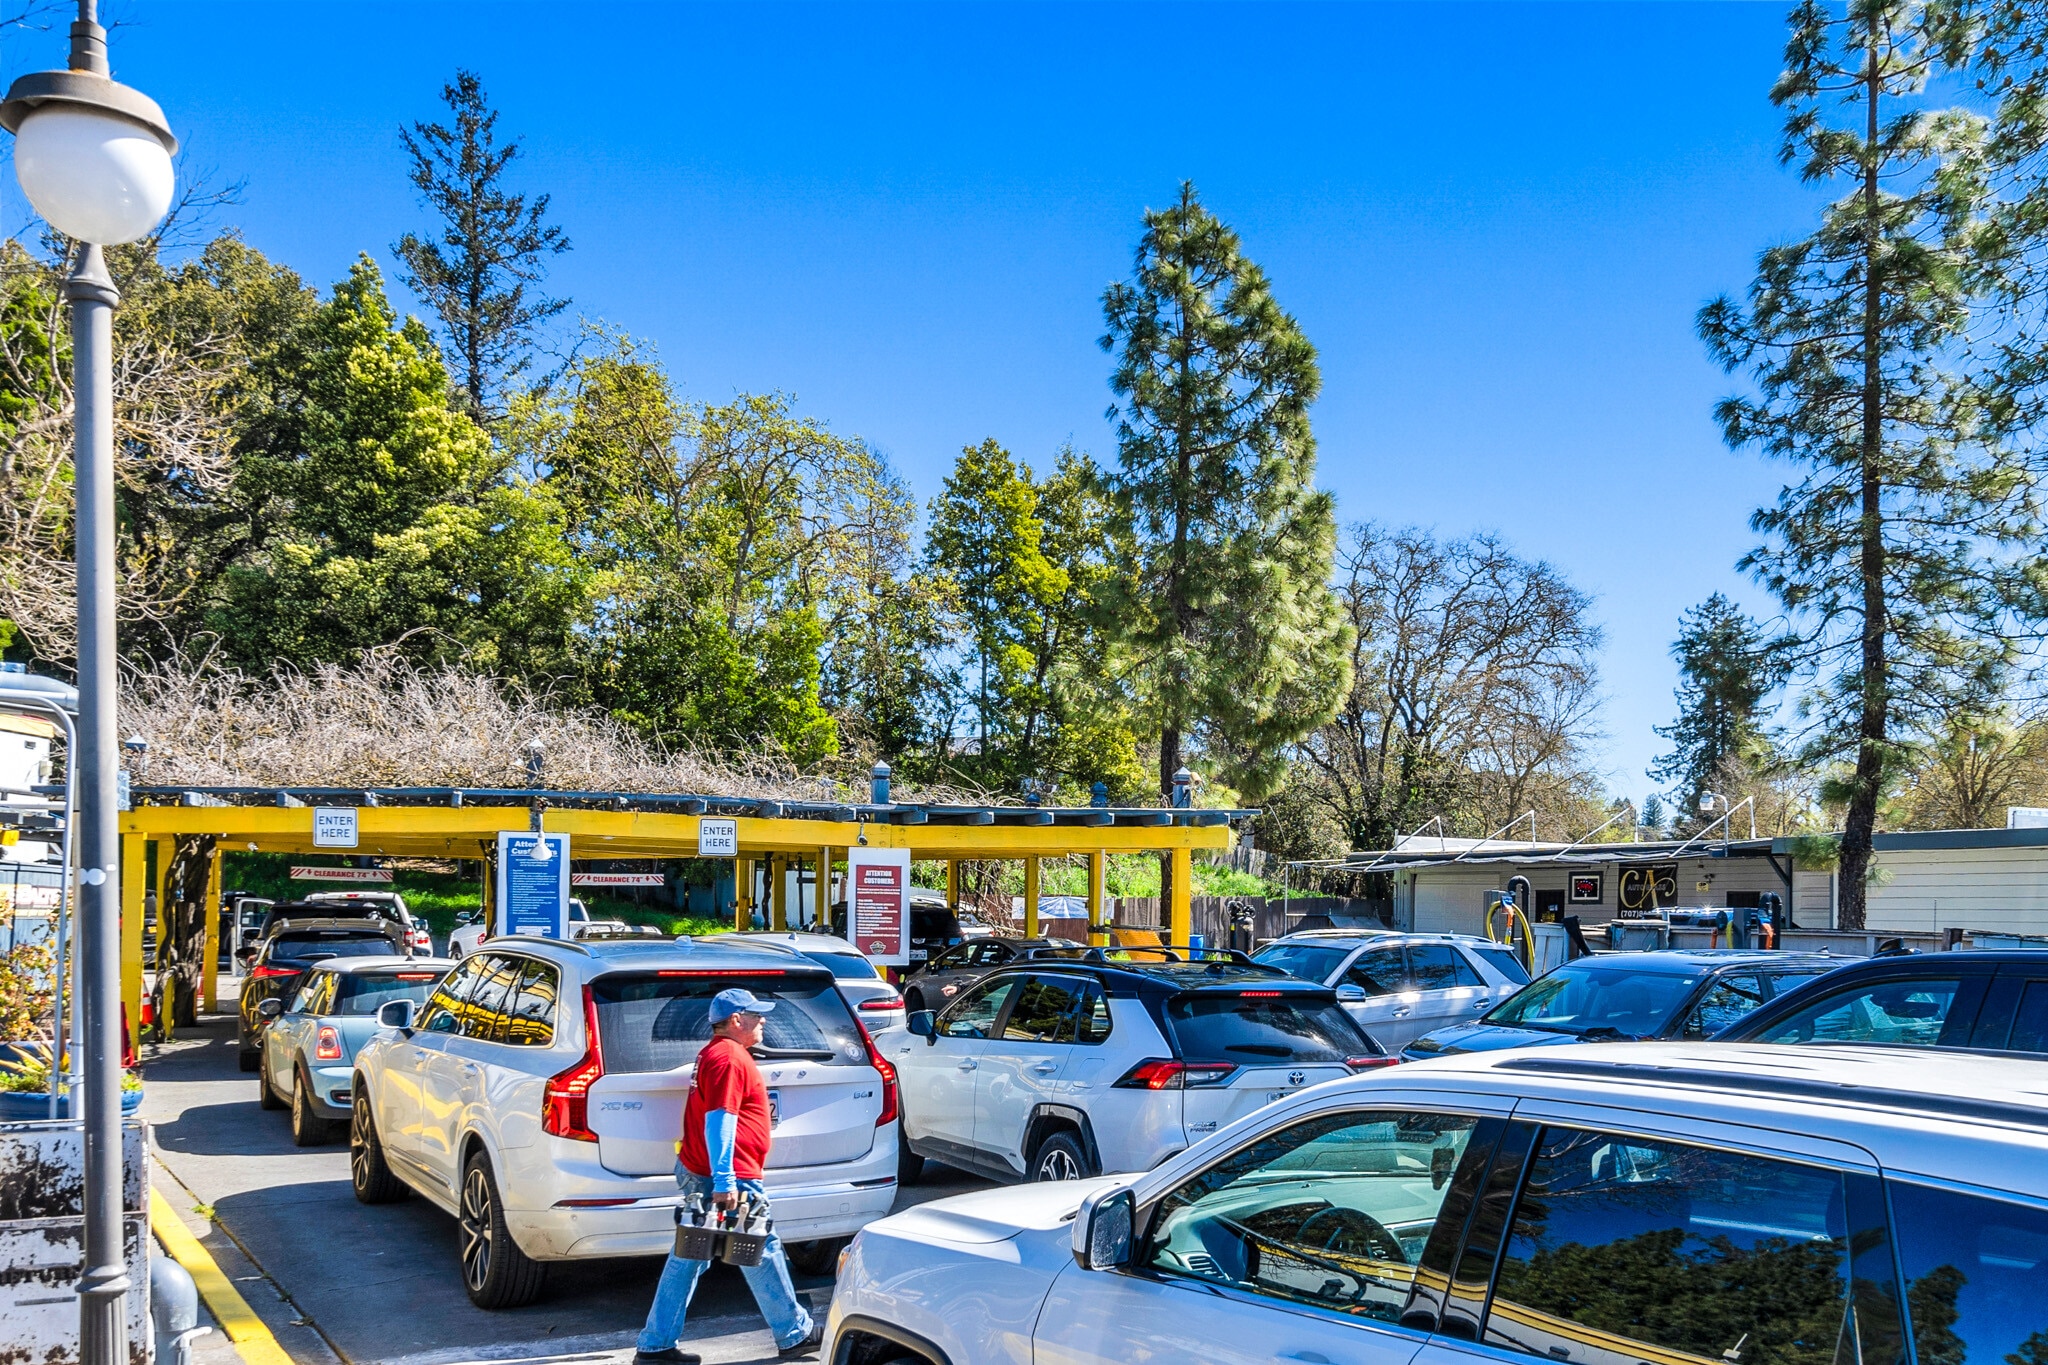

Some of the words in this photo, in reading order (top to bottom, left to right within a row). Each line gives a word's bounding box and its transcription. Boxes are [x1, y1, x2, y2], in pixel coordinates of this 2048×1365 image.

[319, 816, 353, 825] ENTER
[321, 829, 350, 838] HERE
[703, 826, 733, 836] ENTER
[514, 840, 555, 848] Attenon
[705, 838, 730, 847] HERE
[314, 870, 355, 878] CLEARANCE
